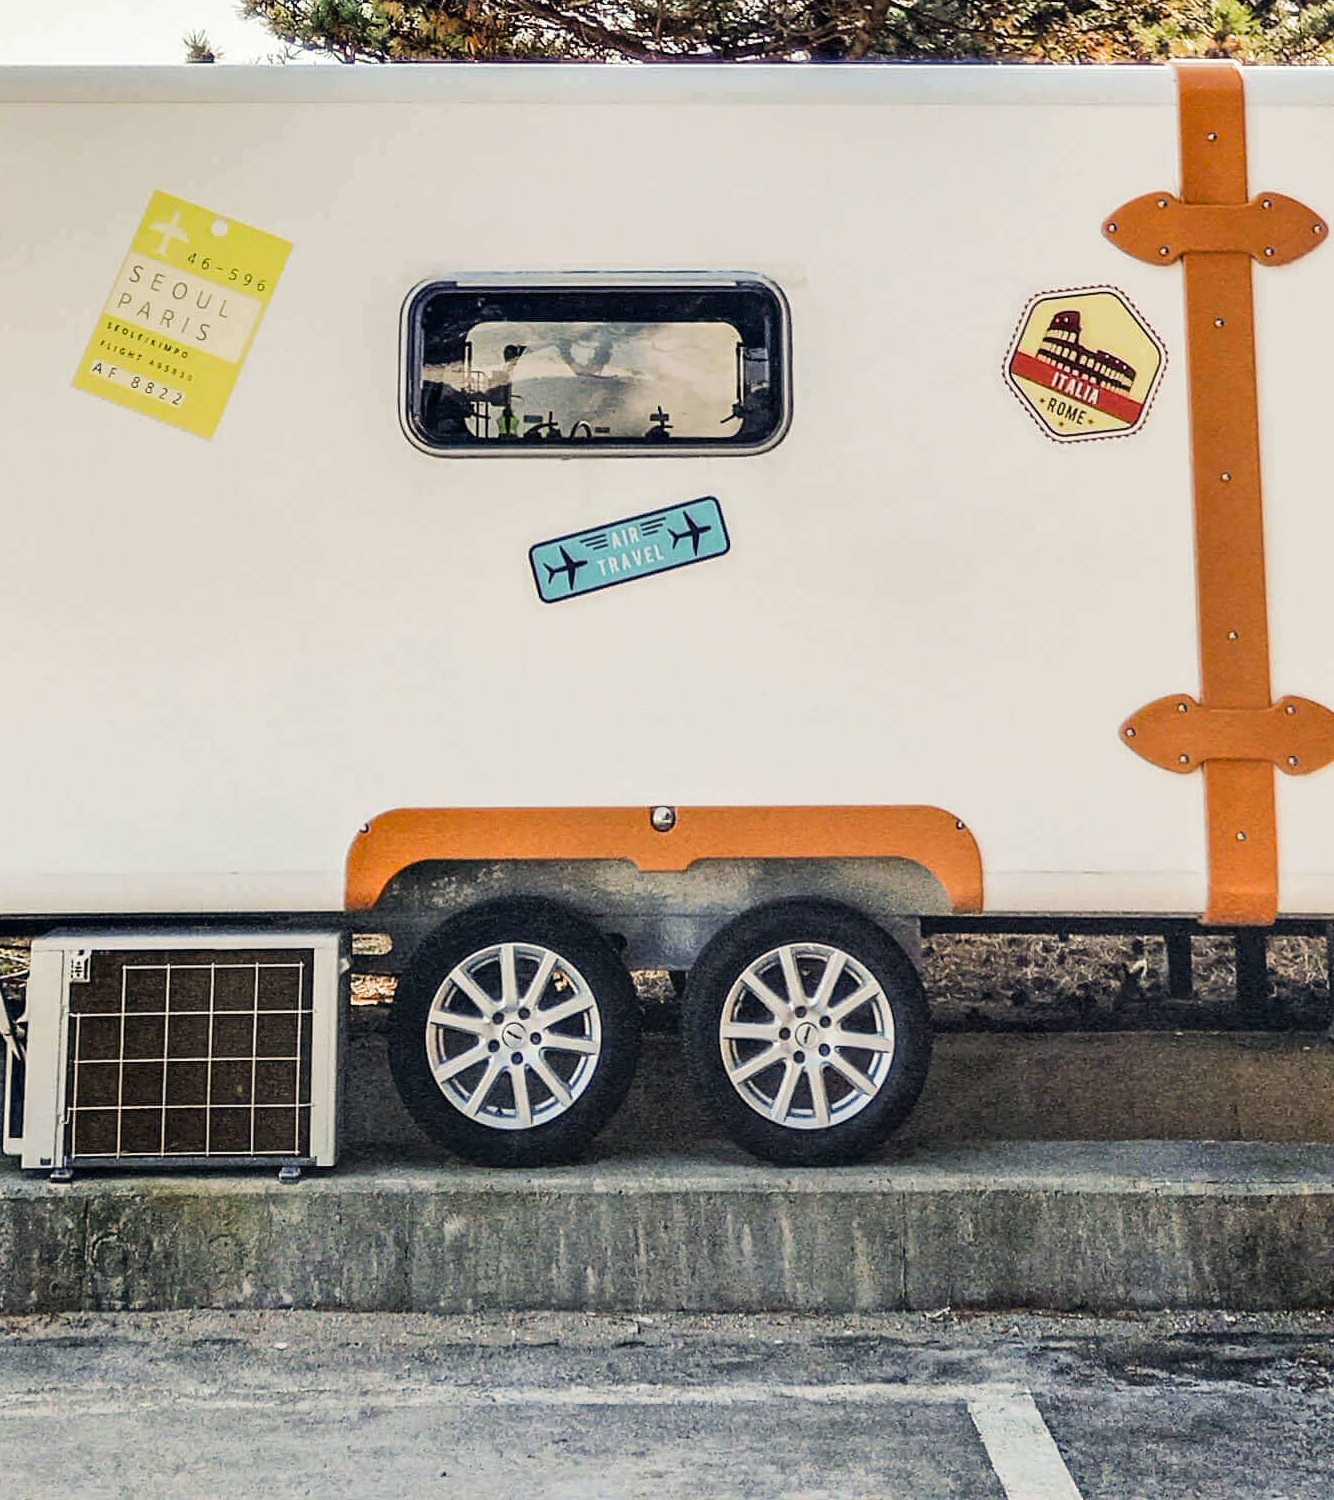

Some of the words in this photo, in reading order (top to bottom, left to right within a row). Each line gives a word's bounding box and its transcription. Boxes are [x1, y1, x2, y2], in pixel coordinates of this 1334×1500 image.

[187, 252, 267, 292] 46-596
[129, 265, 229, 319] SEOUL
[117, 293, 211, 342] PARIS
[100, 340, 142, 361] FLIGHT
[92, 362, 117, 378] AF
[130, 376, 183, 405] 8822
[1050, 371, 1100, 405] ITALIA
[1047, 397, 1087, 425] ROME
[611, 526, 640, 549] AIR
[597, 544, 665, 577] TRAVEL
